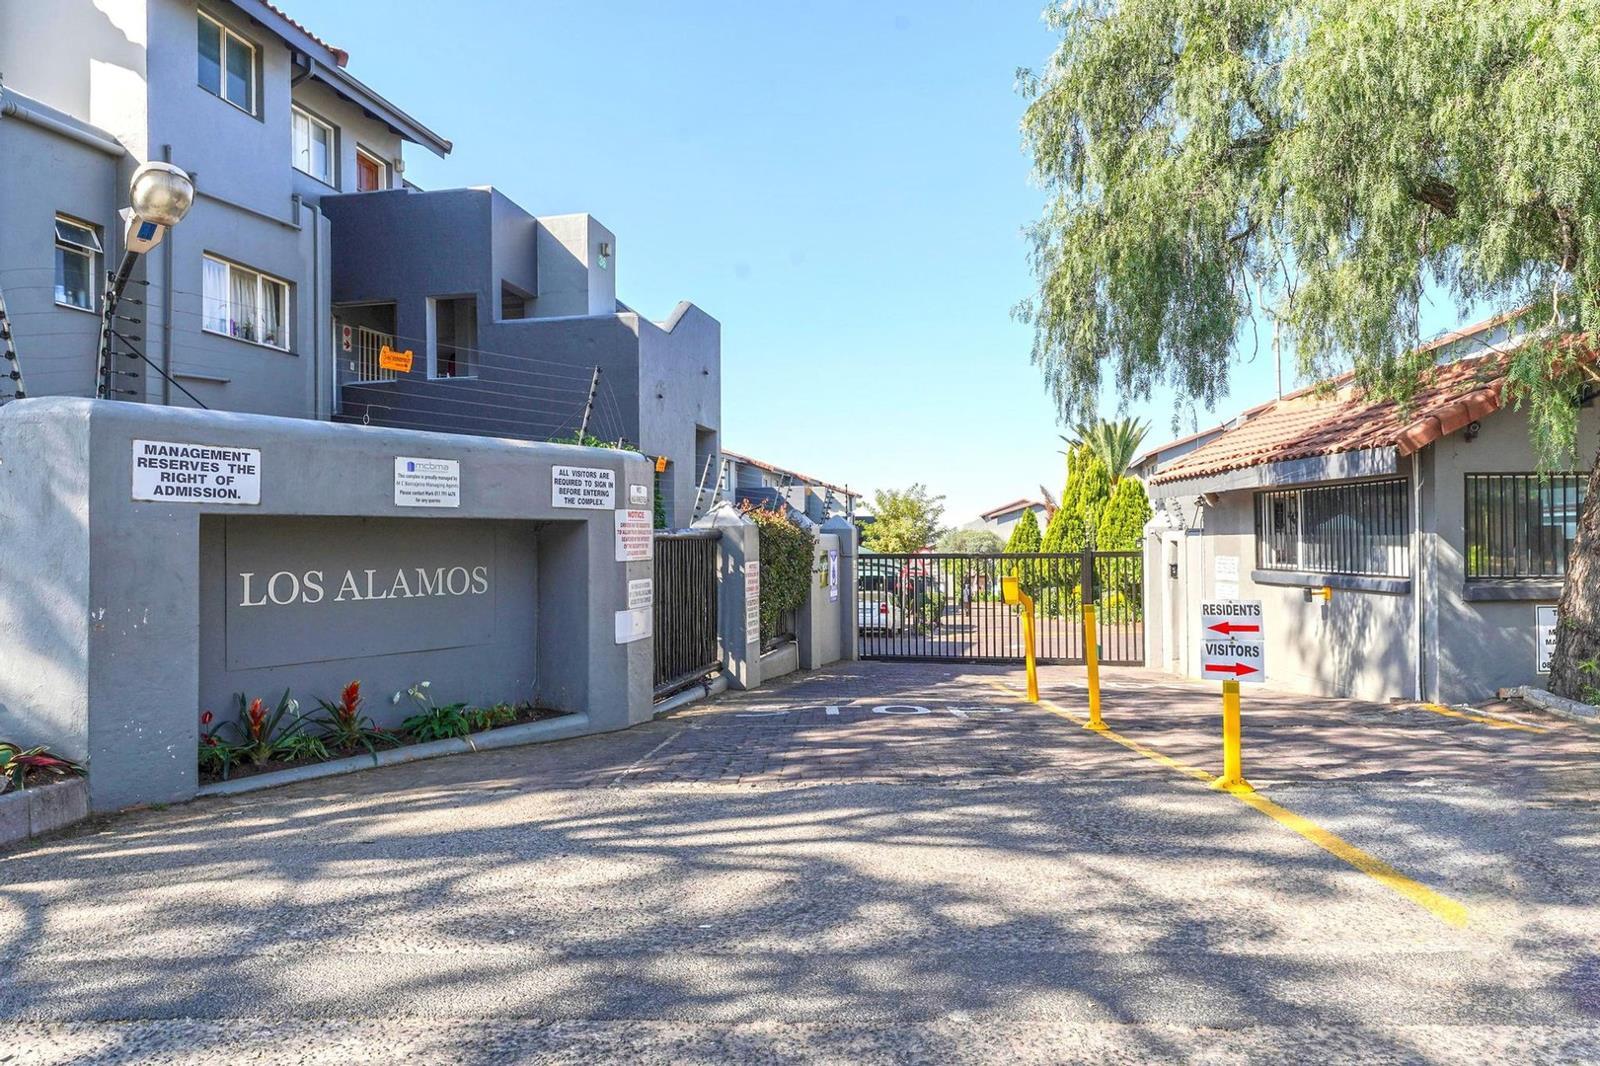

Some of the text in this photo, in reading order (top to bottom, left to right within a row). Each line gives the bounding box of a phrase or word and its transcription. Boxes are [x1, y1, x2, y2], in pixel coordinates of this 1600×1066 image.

[144, 444, 251, 462] MANAGEMENT
[137, 457, 256, 475] RESERVES THE
[160, 472, 235, 486] RIGHT OF
[572, 470, 597, 478] VISITORS
[554, 478, 582, 486] REQUIRED
[153, 485, 241, 499] ADMISSION.
[583, 489, 610, 497] ENTERING
[239, 566, 489, 607] LOS ALAMOS
[1202, 604, 1260, 616] RESIDENTS
[1205, 643, 1260, 658] VISITORS
